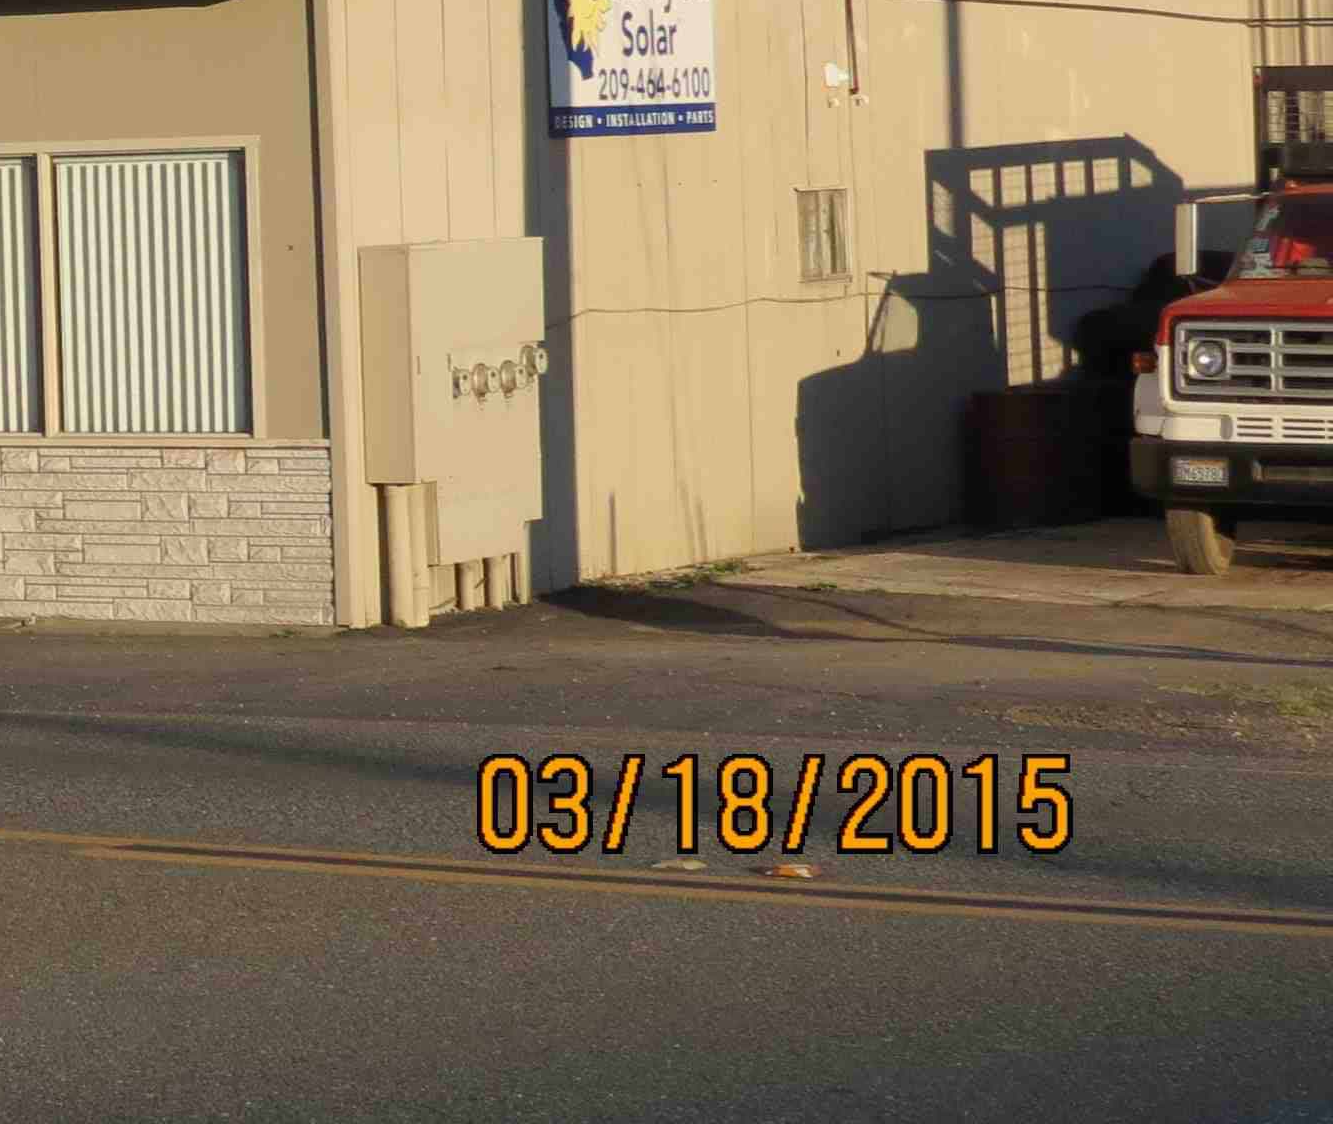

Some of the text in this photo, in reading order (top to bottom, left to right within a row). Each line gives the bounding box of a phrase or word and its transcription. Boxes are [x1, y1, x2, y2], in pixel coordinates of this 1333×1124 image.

[621, 9, 677, 57] Solar
[598, 67, 710, 100] 209-464-6100
[555, 110, 714, 130] DESIGN INSTALLATION PARTS
